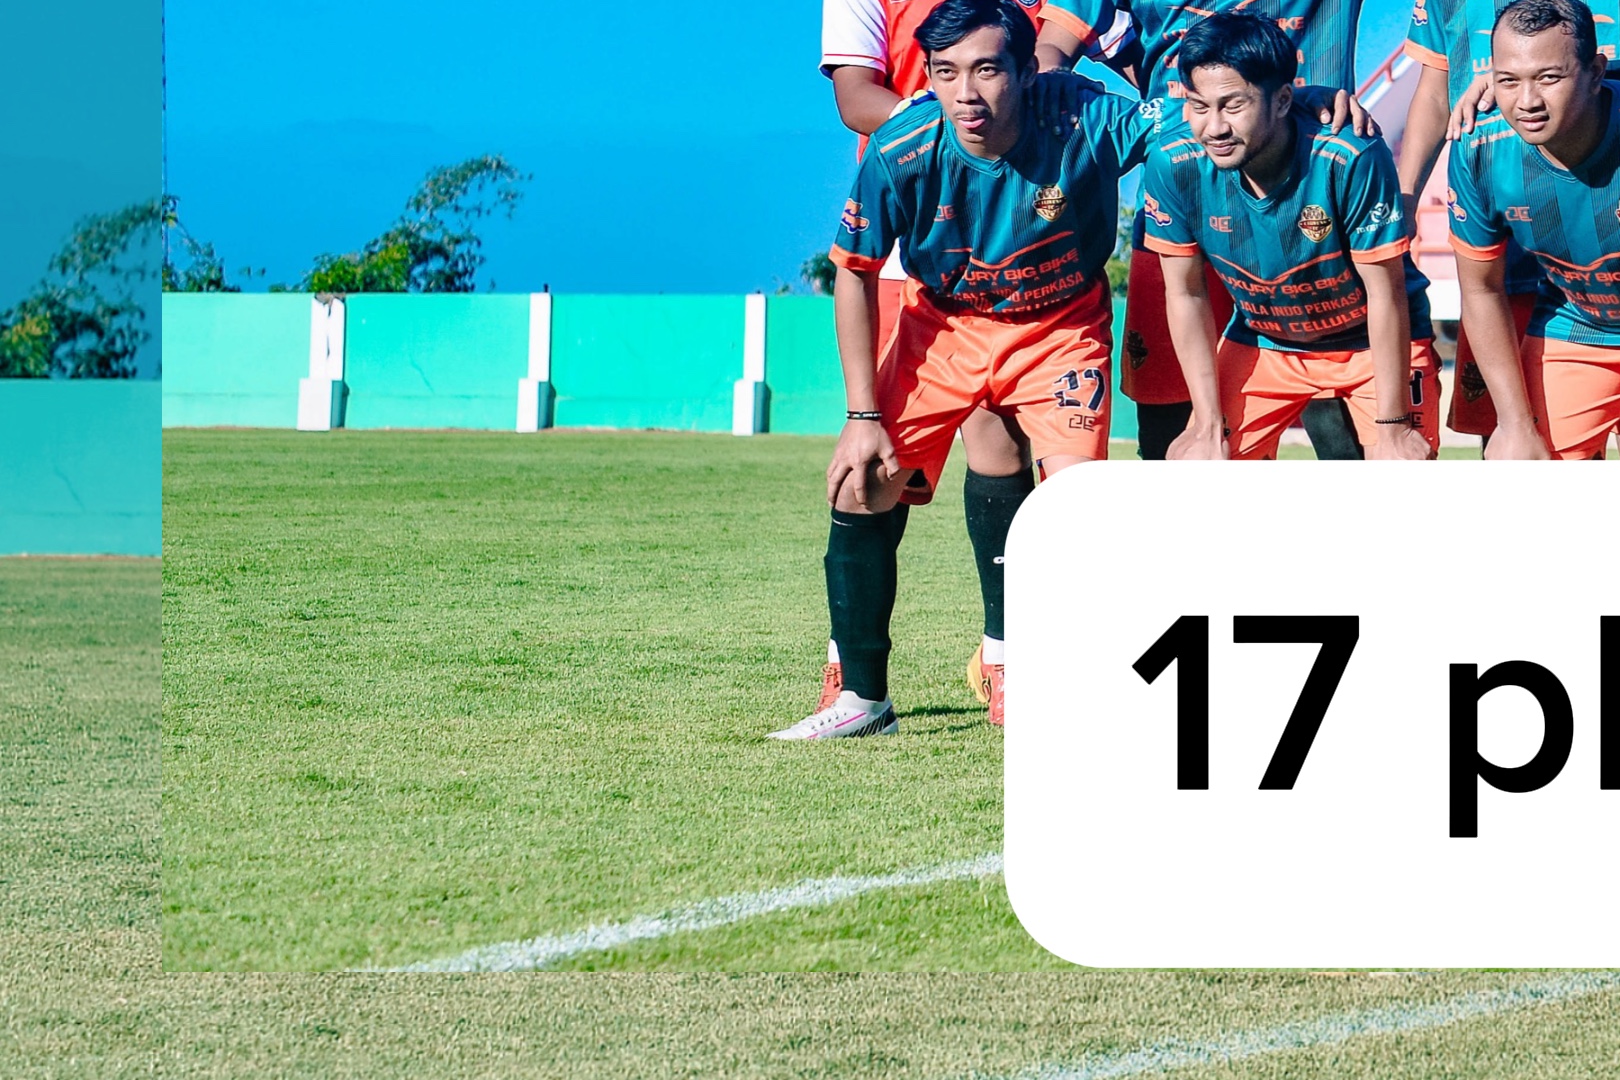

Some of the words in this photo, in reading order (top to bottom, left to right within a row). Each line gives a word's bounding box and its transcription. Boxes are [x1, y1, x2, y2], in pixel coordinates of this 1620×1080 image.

[1004, 266, 1037, 281] BIG
[1039, 247, 1079, 274] BIKE
[1024, 270, 1085, 302] PERKASA
[1281, 282, 1314, 296] BIG
[1314, 269, 1353, 290] BIKE
[1270, 304, 1303, 317] INDO
[1587, 293, 1620, 305] INDO
